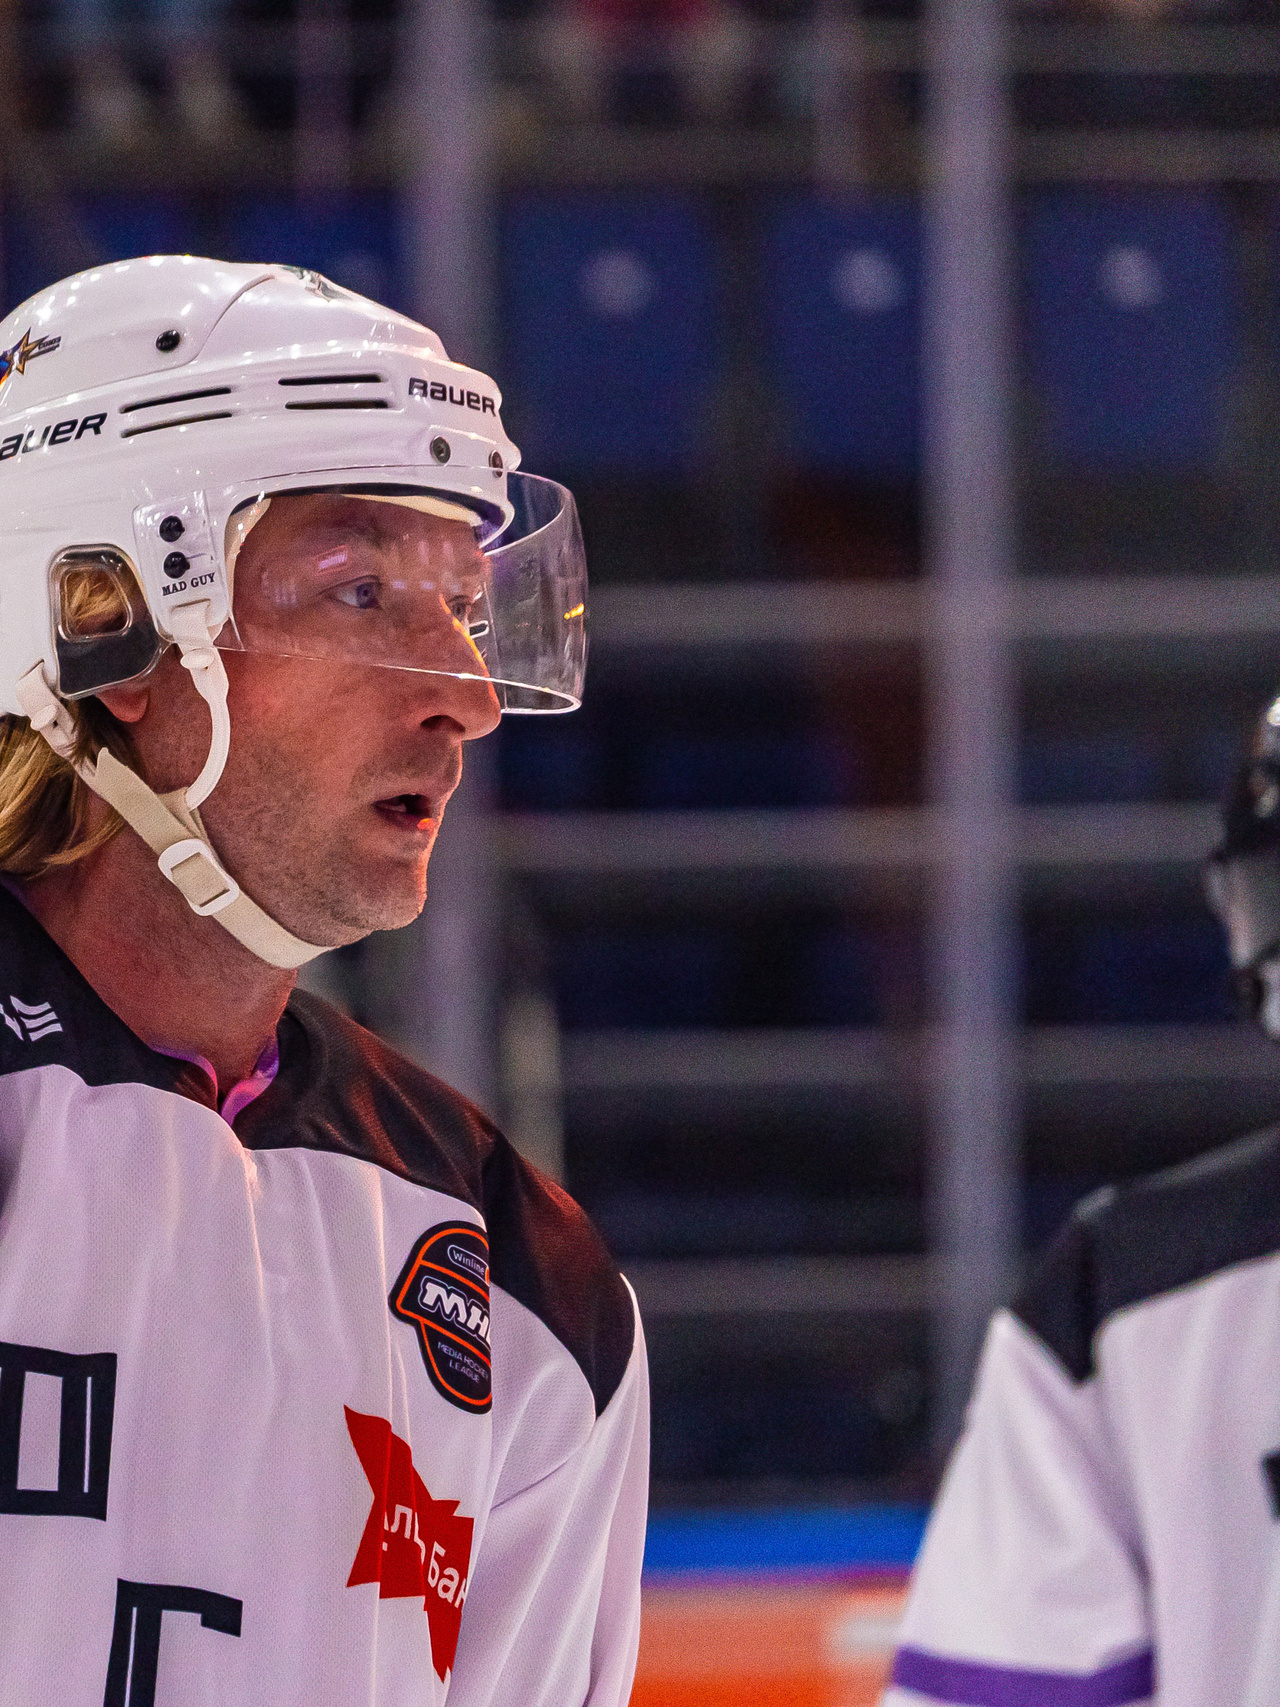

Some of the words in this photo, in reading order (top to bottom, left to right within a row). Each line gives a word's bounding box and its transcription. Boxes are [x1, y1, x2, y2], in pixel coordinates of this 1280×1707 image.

[162, 581, 187, 596] MAD
[190, 572, 216, 588] GUY
[452, 1250, 486, 1276] Winline
[437, 1341, 463, 1361] MEDIA
[448, 1359, 481, 1384] LEAGUE
